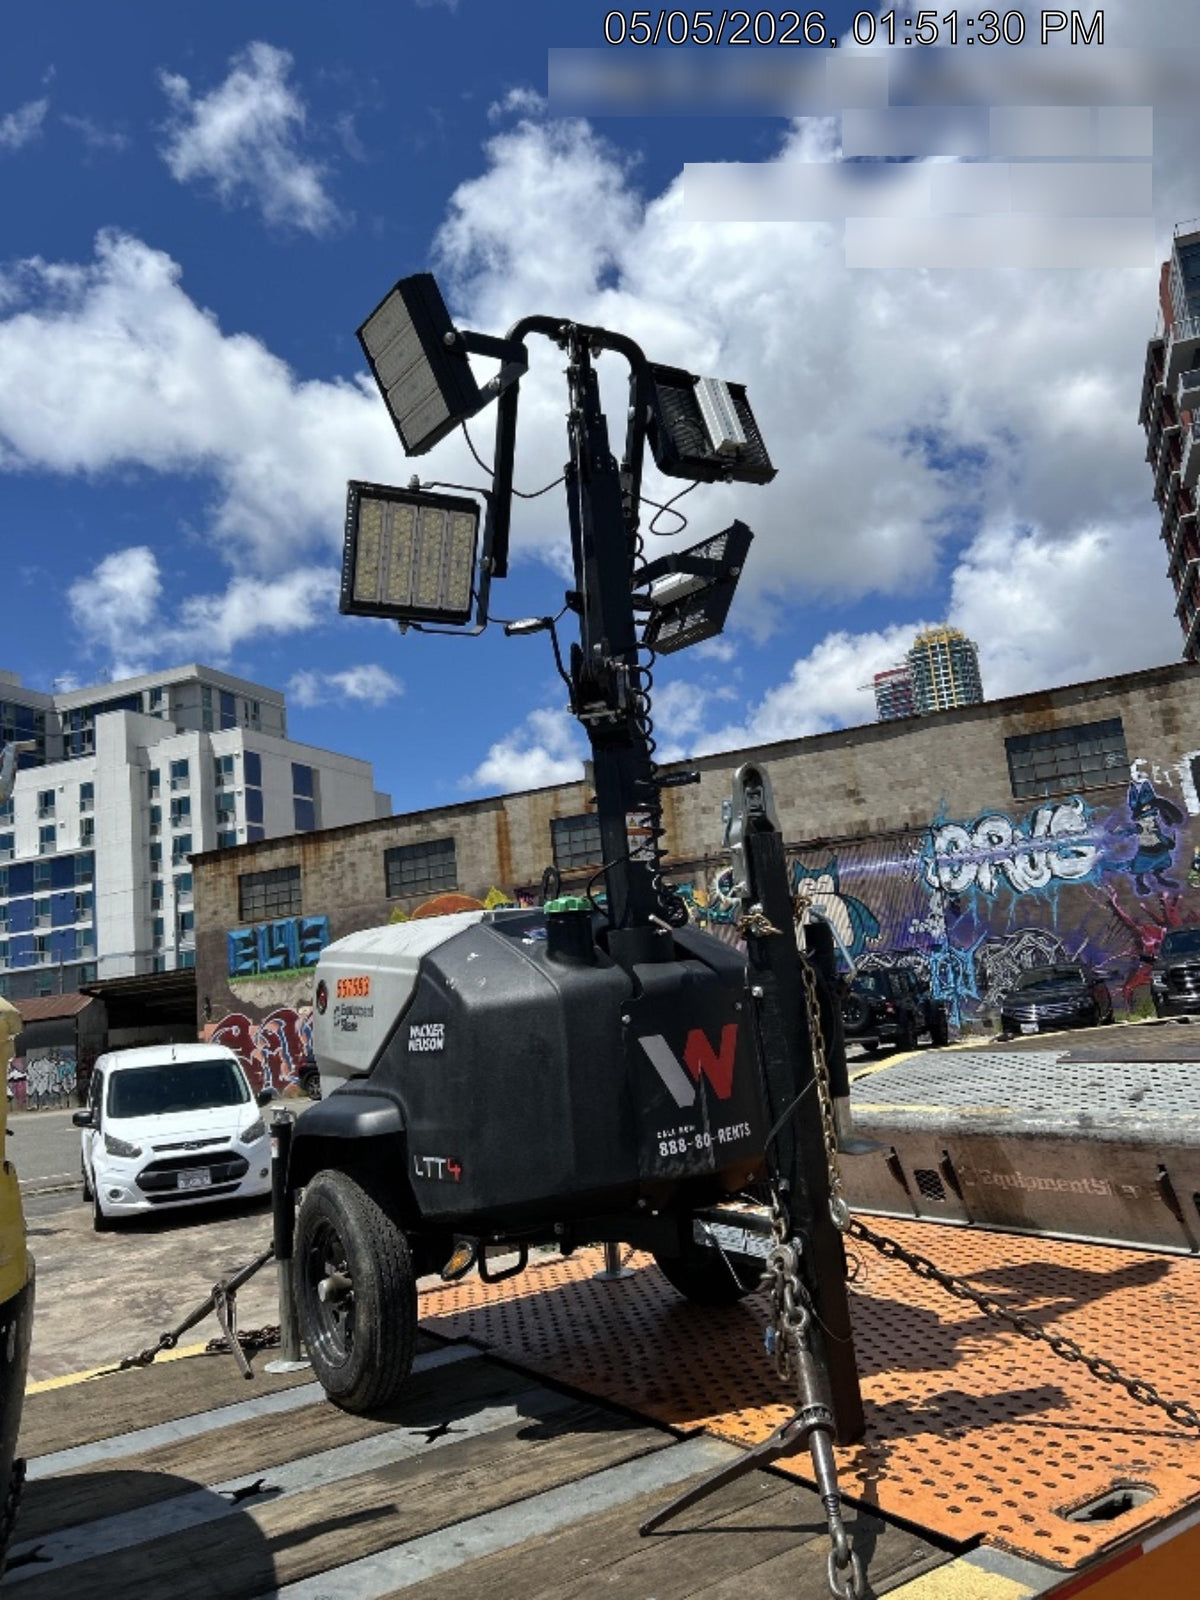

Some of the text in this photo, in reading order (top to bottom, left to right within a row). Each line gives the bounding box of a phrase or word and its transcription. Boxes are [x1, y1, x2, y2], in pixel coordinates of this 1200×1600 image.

[409, 1023, 445, 1039] WACKER
[408, 1037, 444, 1052] NEUSON
[658, 1121, 752, 1157] 888-80-RENTS
[413, 1155, 462, 1182] LTT4
